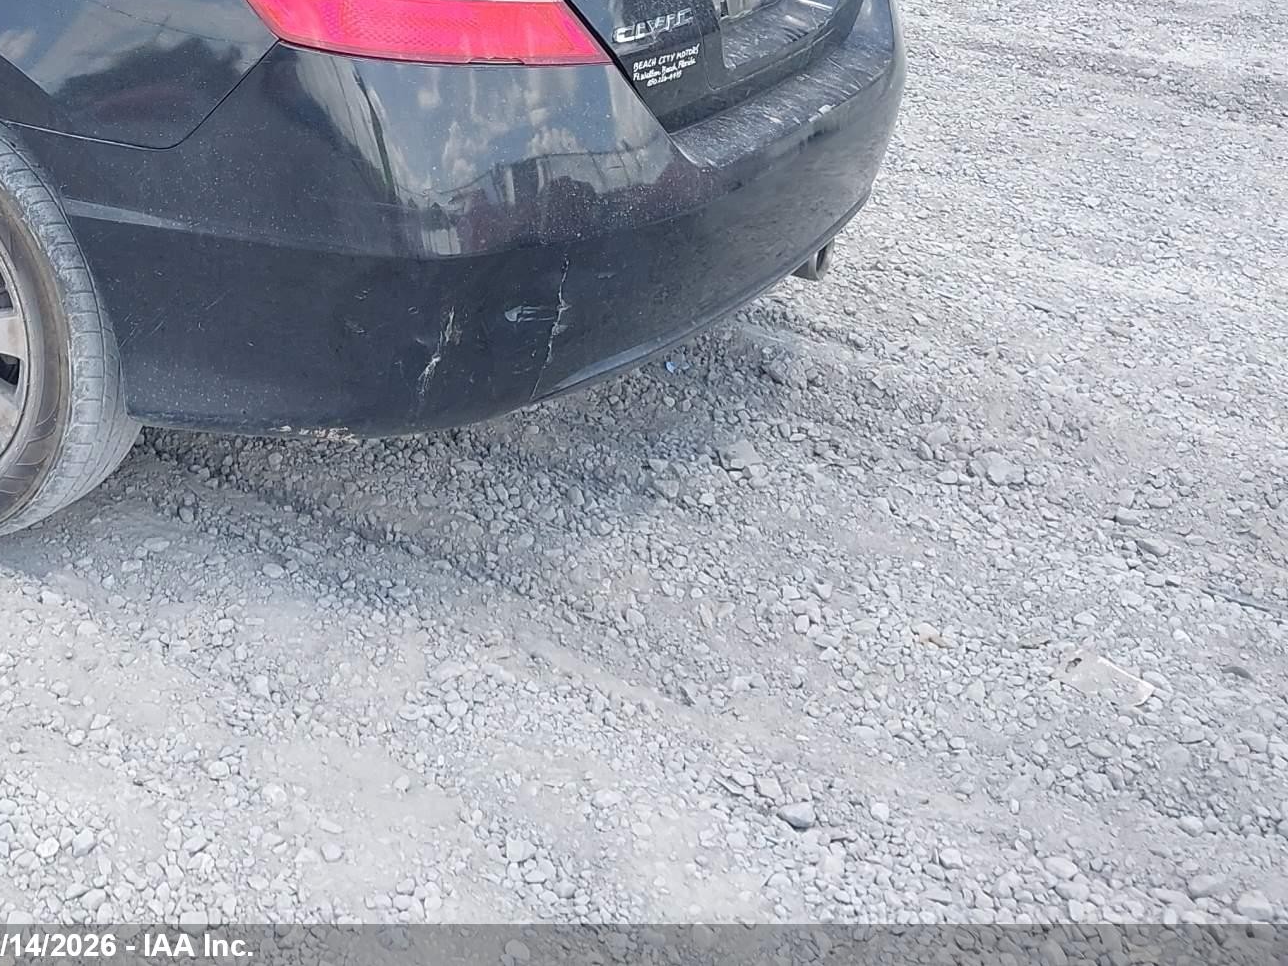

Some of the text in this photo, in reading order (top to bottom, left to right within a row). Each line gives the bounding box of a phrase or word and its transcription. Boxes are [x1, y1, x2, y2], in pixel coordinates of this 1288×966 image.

[613, 7, 694, 44] CIVIC
[633, 43, 700, 73] BEACH CITY MOTORS
